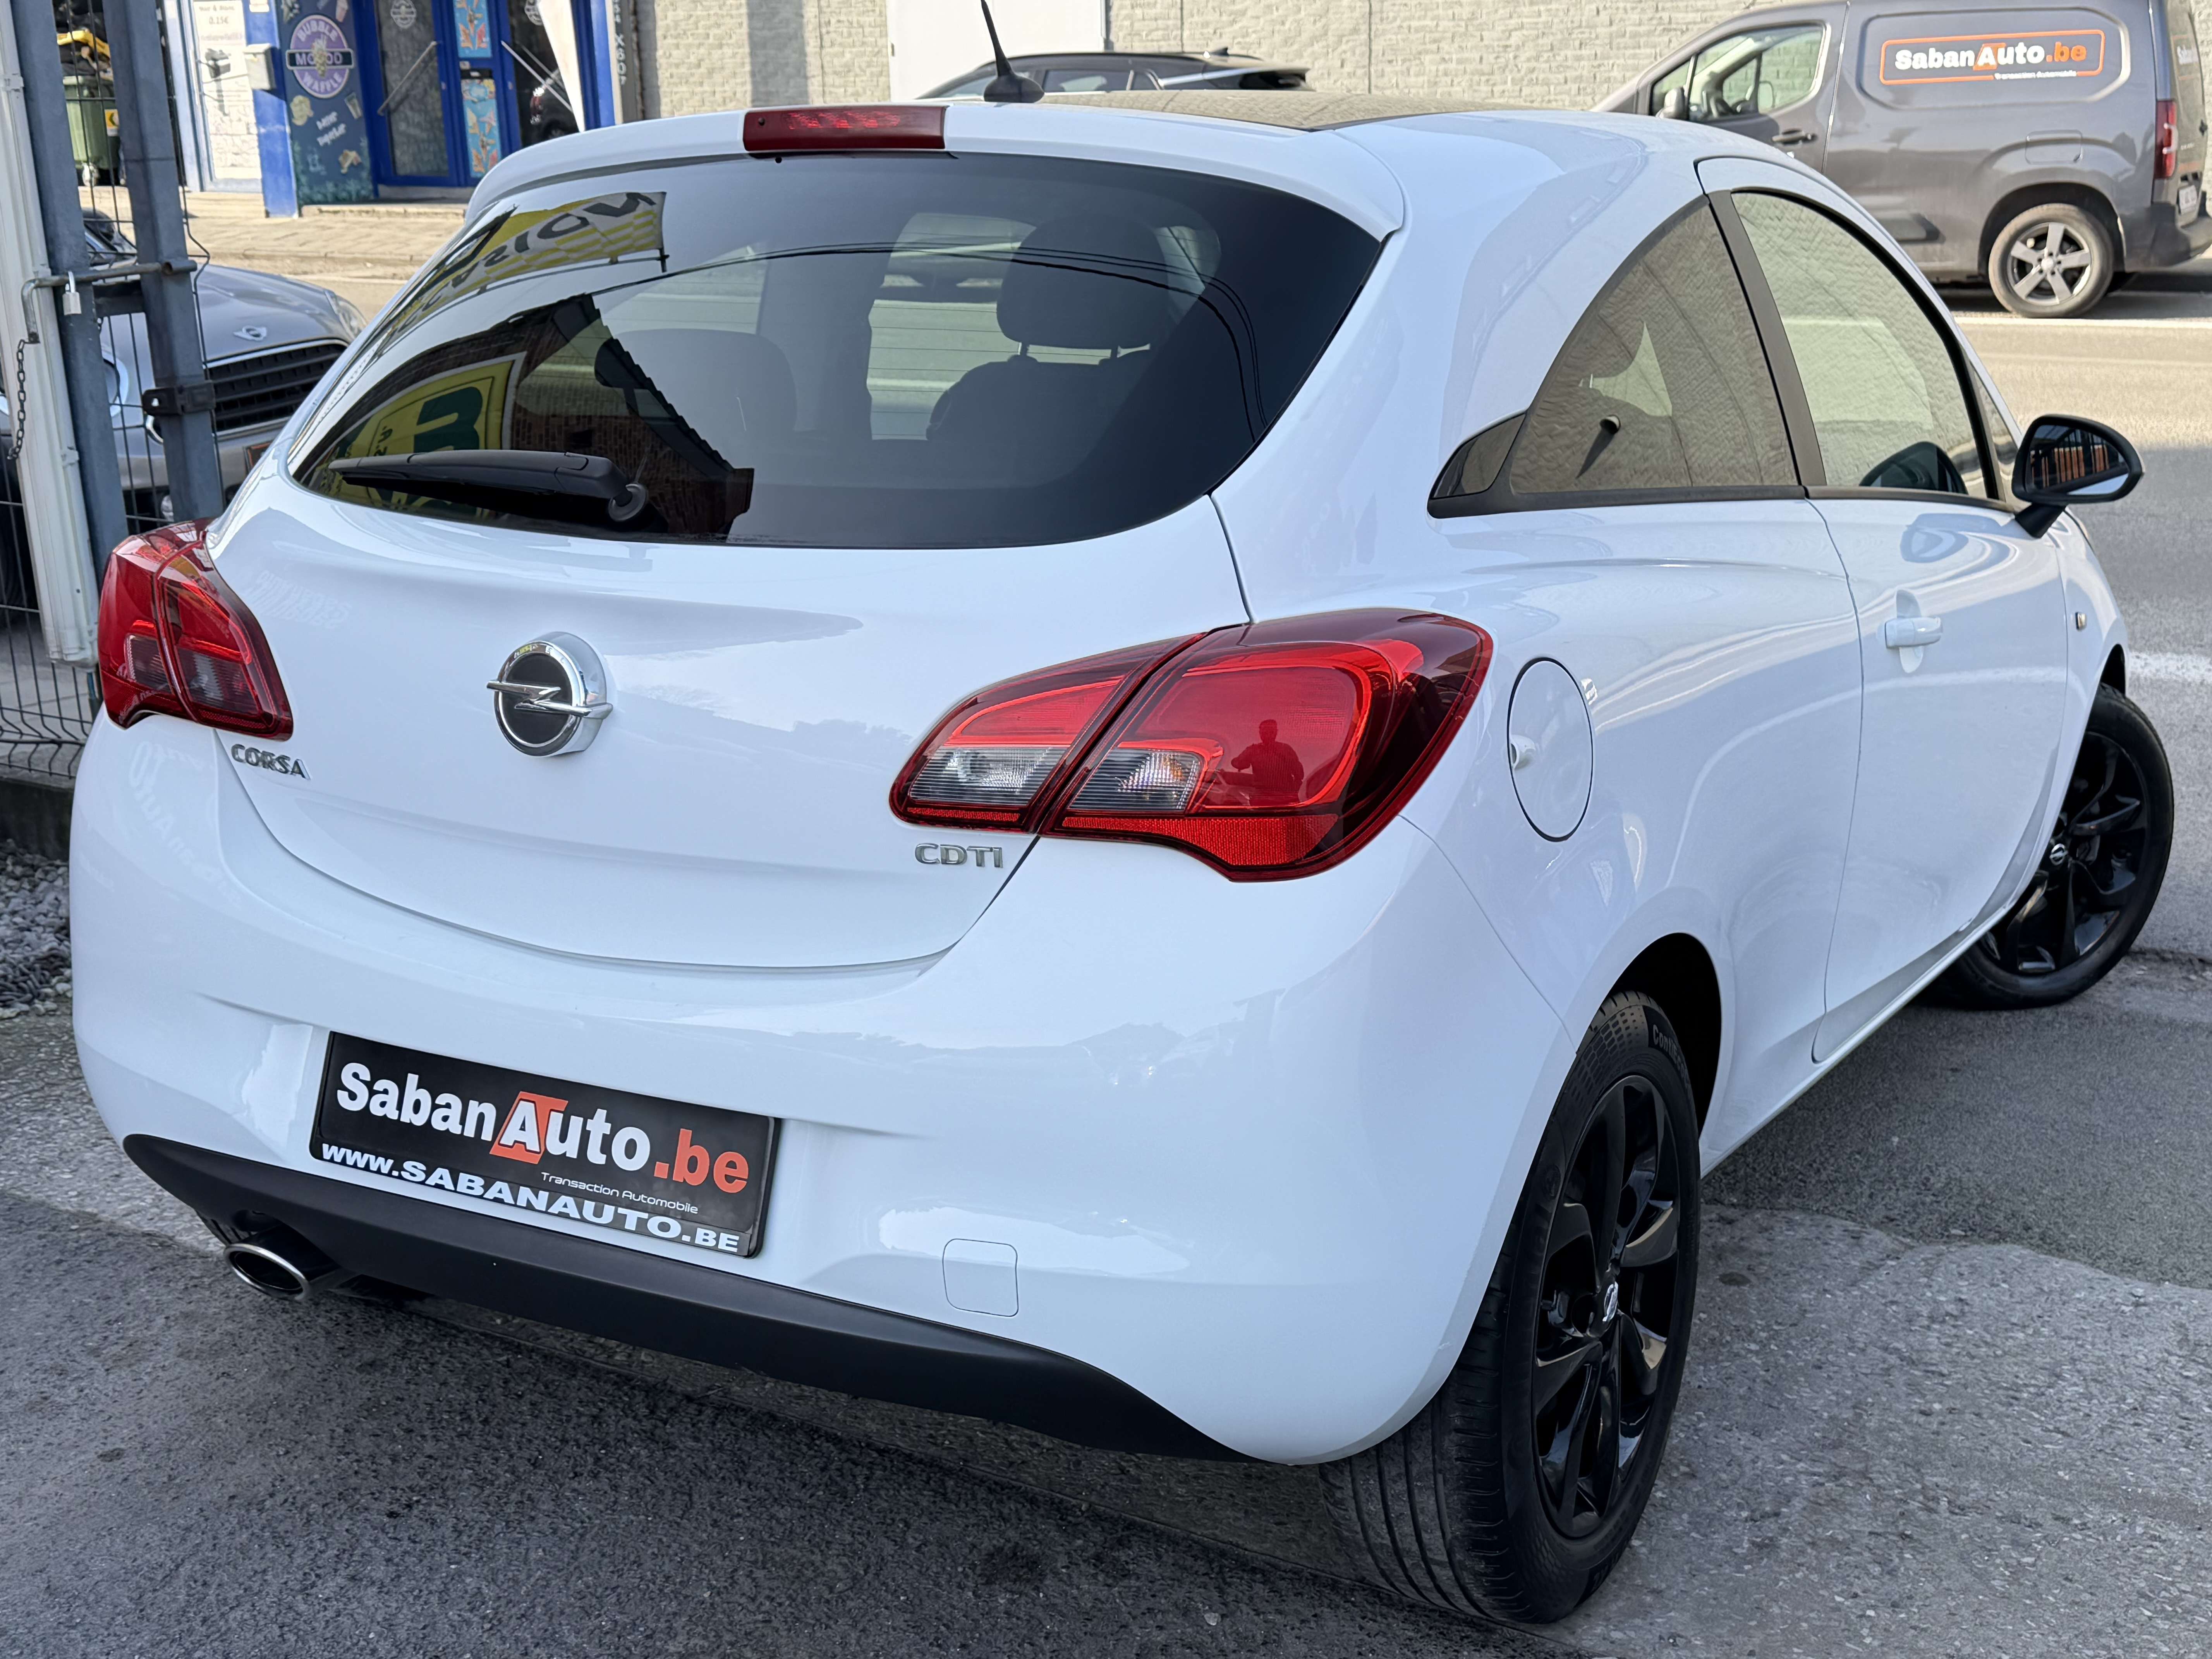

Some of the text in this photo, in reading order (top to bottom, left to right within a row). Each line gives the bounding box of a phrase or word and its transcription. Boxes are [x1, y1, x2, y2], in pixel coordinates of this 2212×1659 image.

[297, 20, 338, 42] BUBBLE
[303, 72, 342, 93] WAFFLE
[231, 744, 311, 780] CORSA
[915, 843, 1003, 868] CDTI
[541, 1171, 698, 1214] Transaction Automobile
